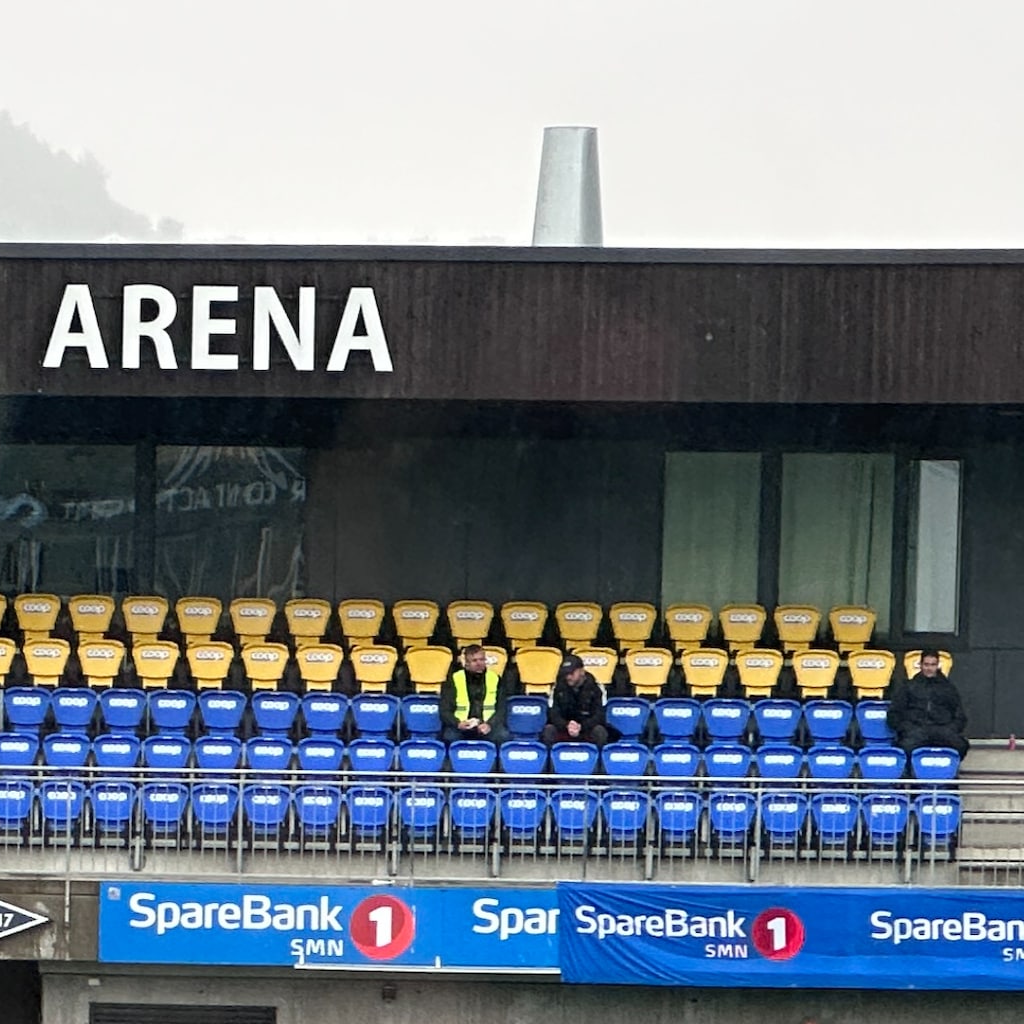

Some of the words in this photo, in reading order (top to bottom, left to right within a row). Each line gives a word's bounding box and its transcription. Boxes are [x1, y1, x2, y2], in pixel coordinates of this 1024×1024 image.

[42, 284, 394, 372] ARENA
[129, 892, 343, 935] SpareBank
[368, 906, 393, 948] 1
[575, 905, 747, 939] SpareBank
[767, 917, 786, 951] 1
[291, 938, 344, 957] SMN
[705, 944, 748, 958] SMN
